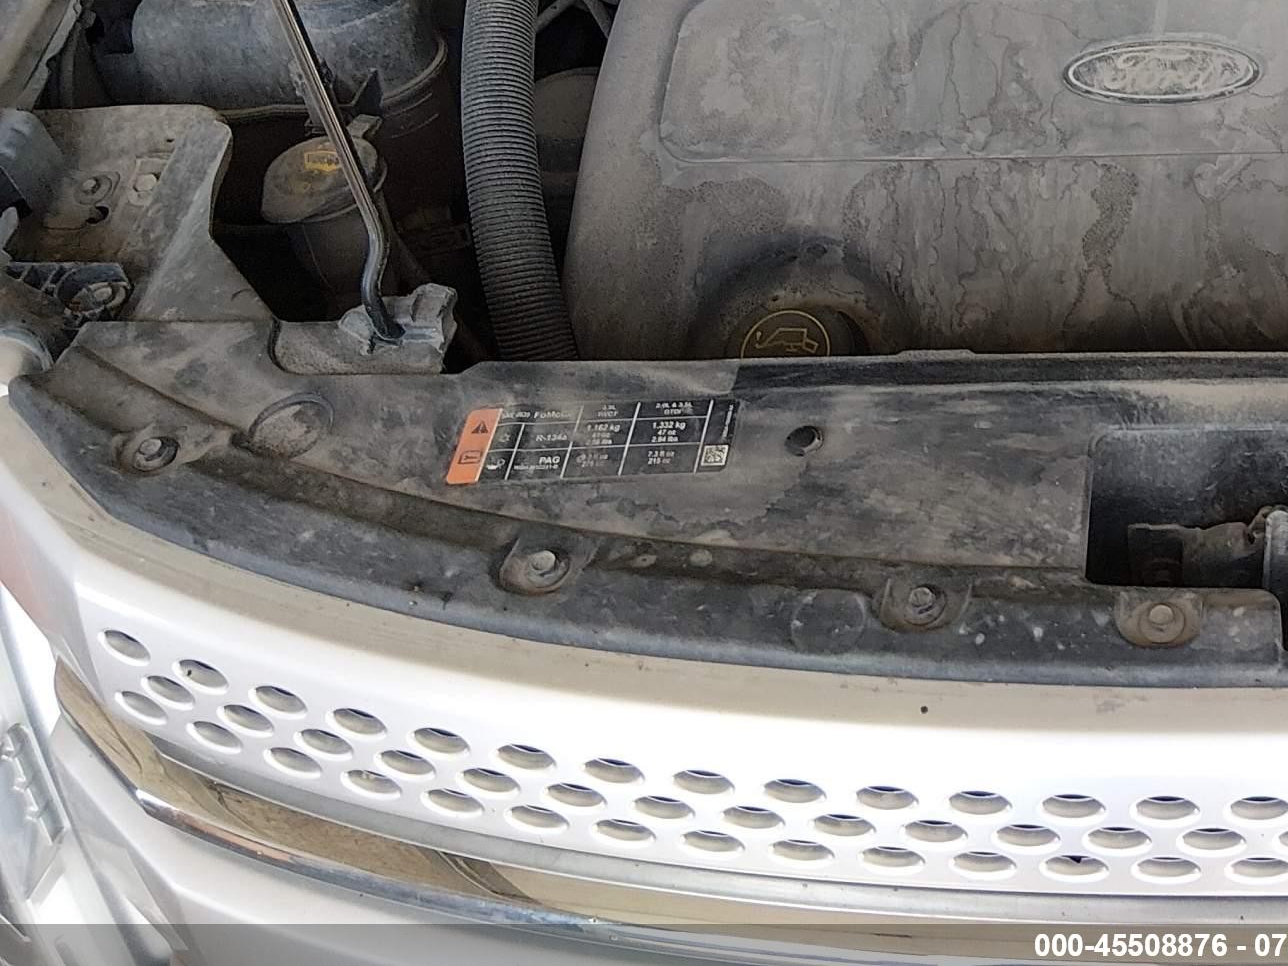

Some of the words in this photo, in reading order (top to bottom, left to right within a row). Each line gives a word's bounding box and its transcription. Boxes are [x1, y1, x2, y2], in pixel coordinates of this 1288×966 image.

[609, 423, 621, 432] kg
[652, 421, 674, 429] 1.332
[675, 421, 686, 430] kg
[538, 456, 561, 464] PAG
